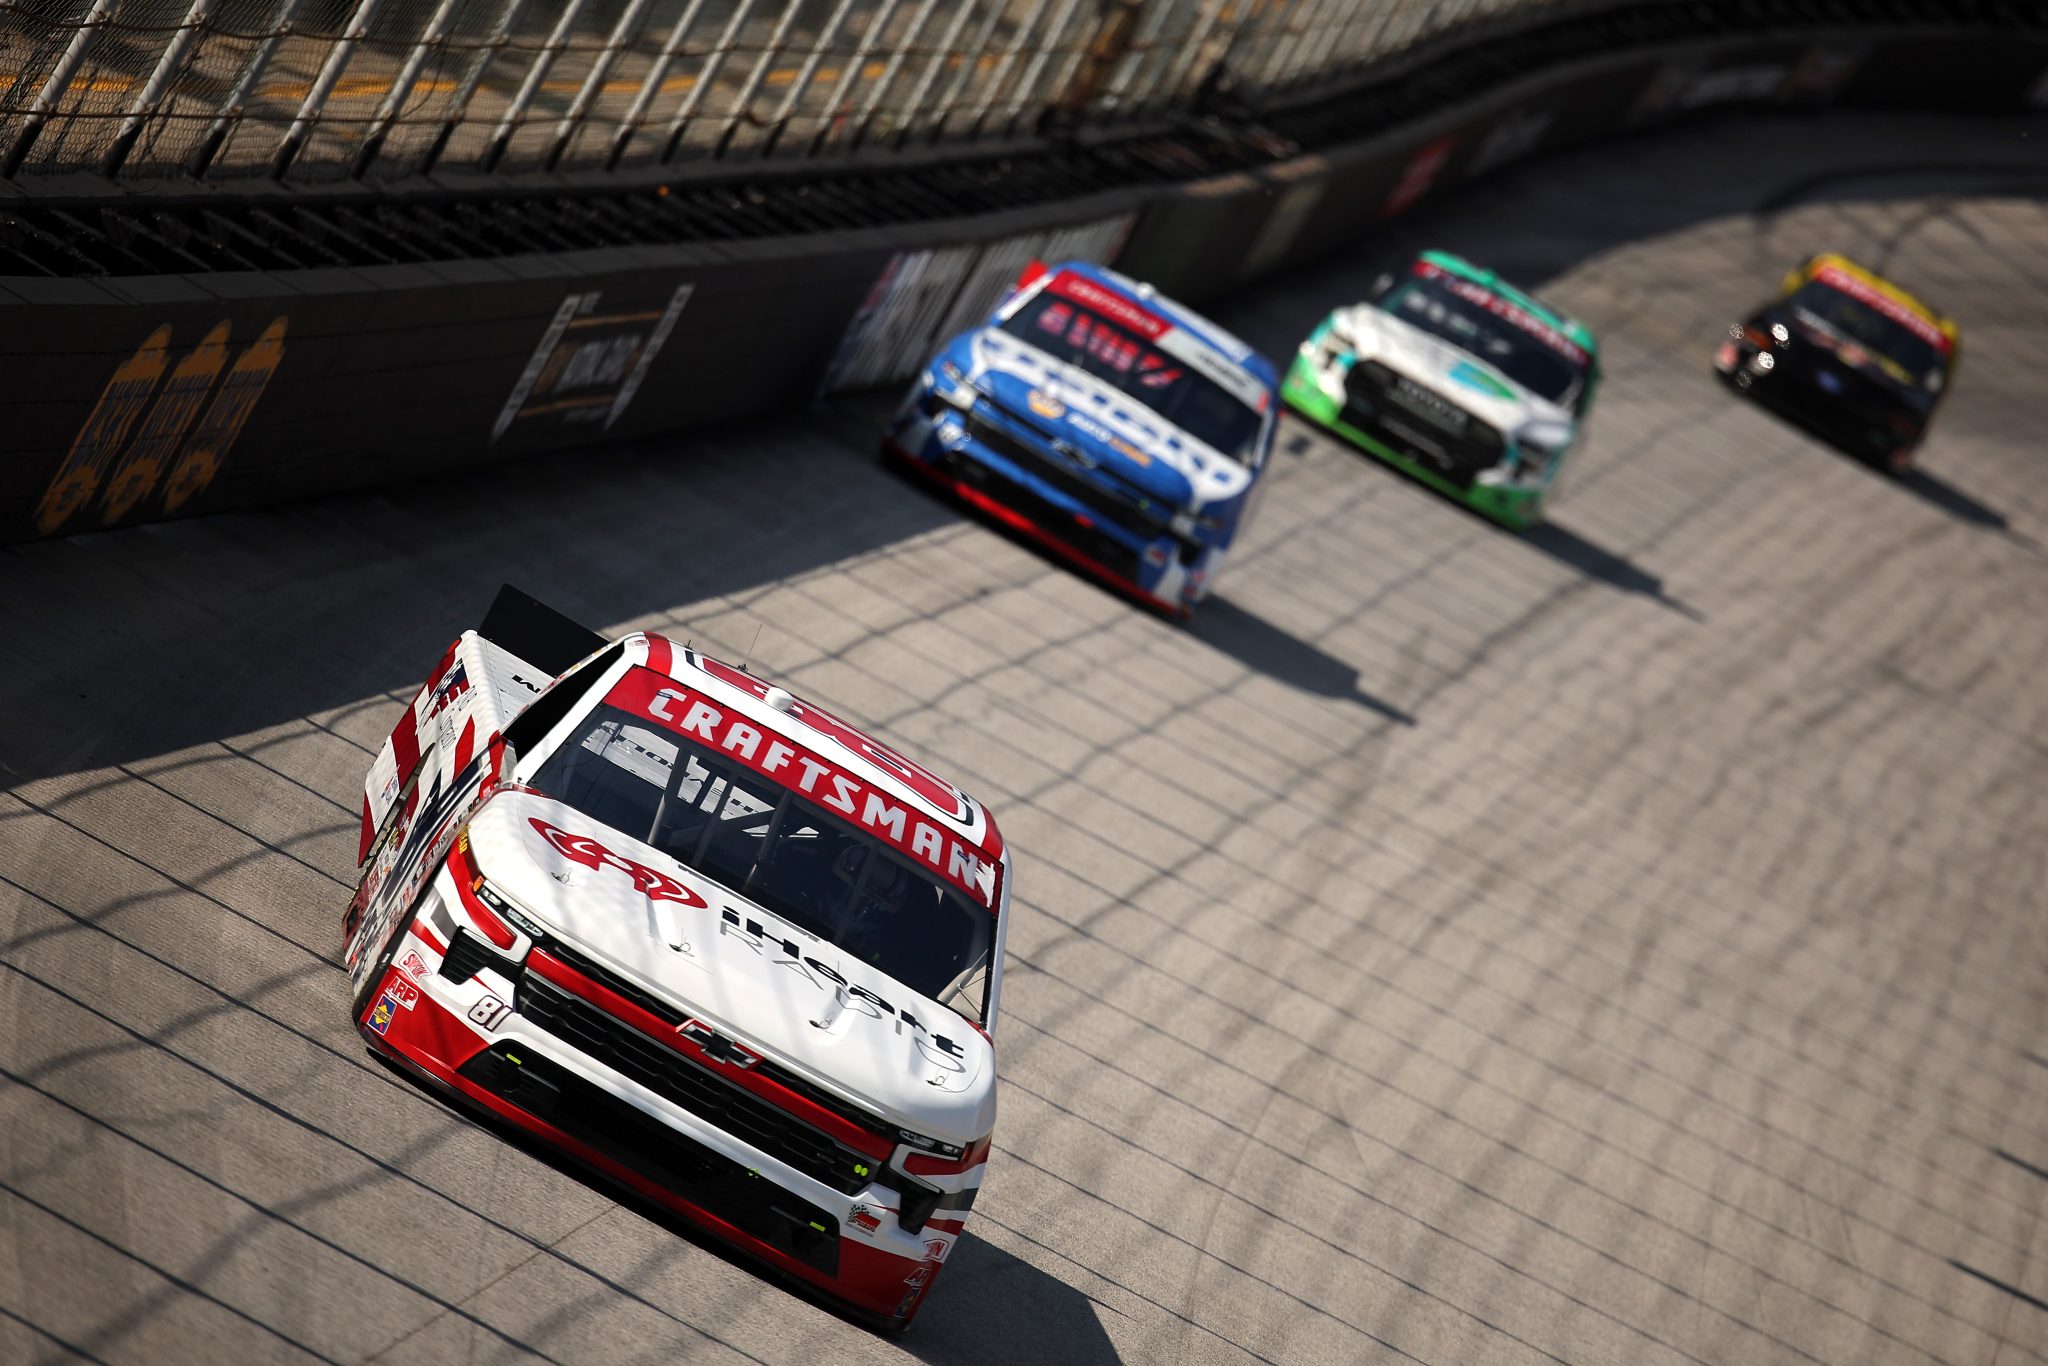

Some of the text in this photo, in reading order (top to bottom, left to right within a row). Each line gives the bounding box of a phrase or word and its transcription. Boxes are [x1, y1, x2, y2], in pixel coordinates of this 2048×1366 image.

[647, 687, 979, 890] CRAFTSMAN
[467, 994, 514, 1033] 81
[722, 905, 965, 1059] iHeart
